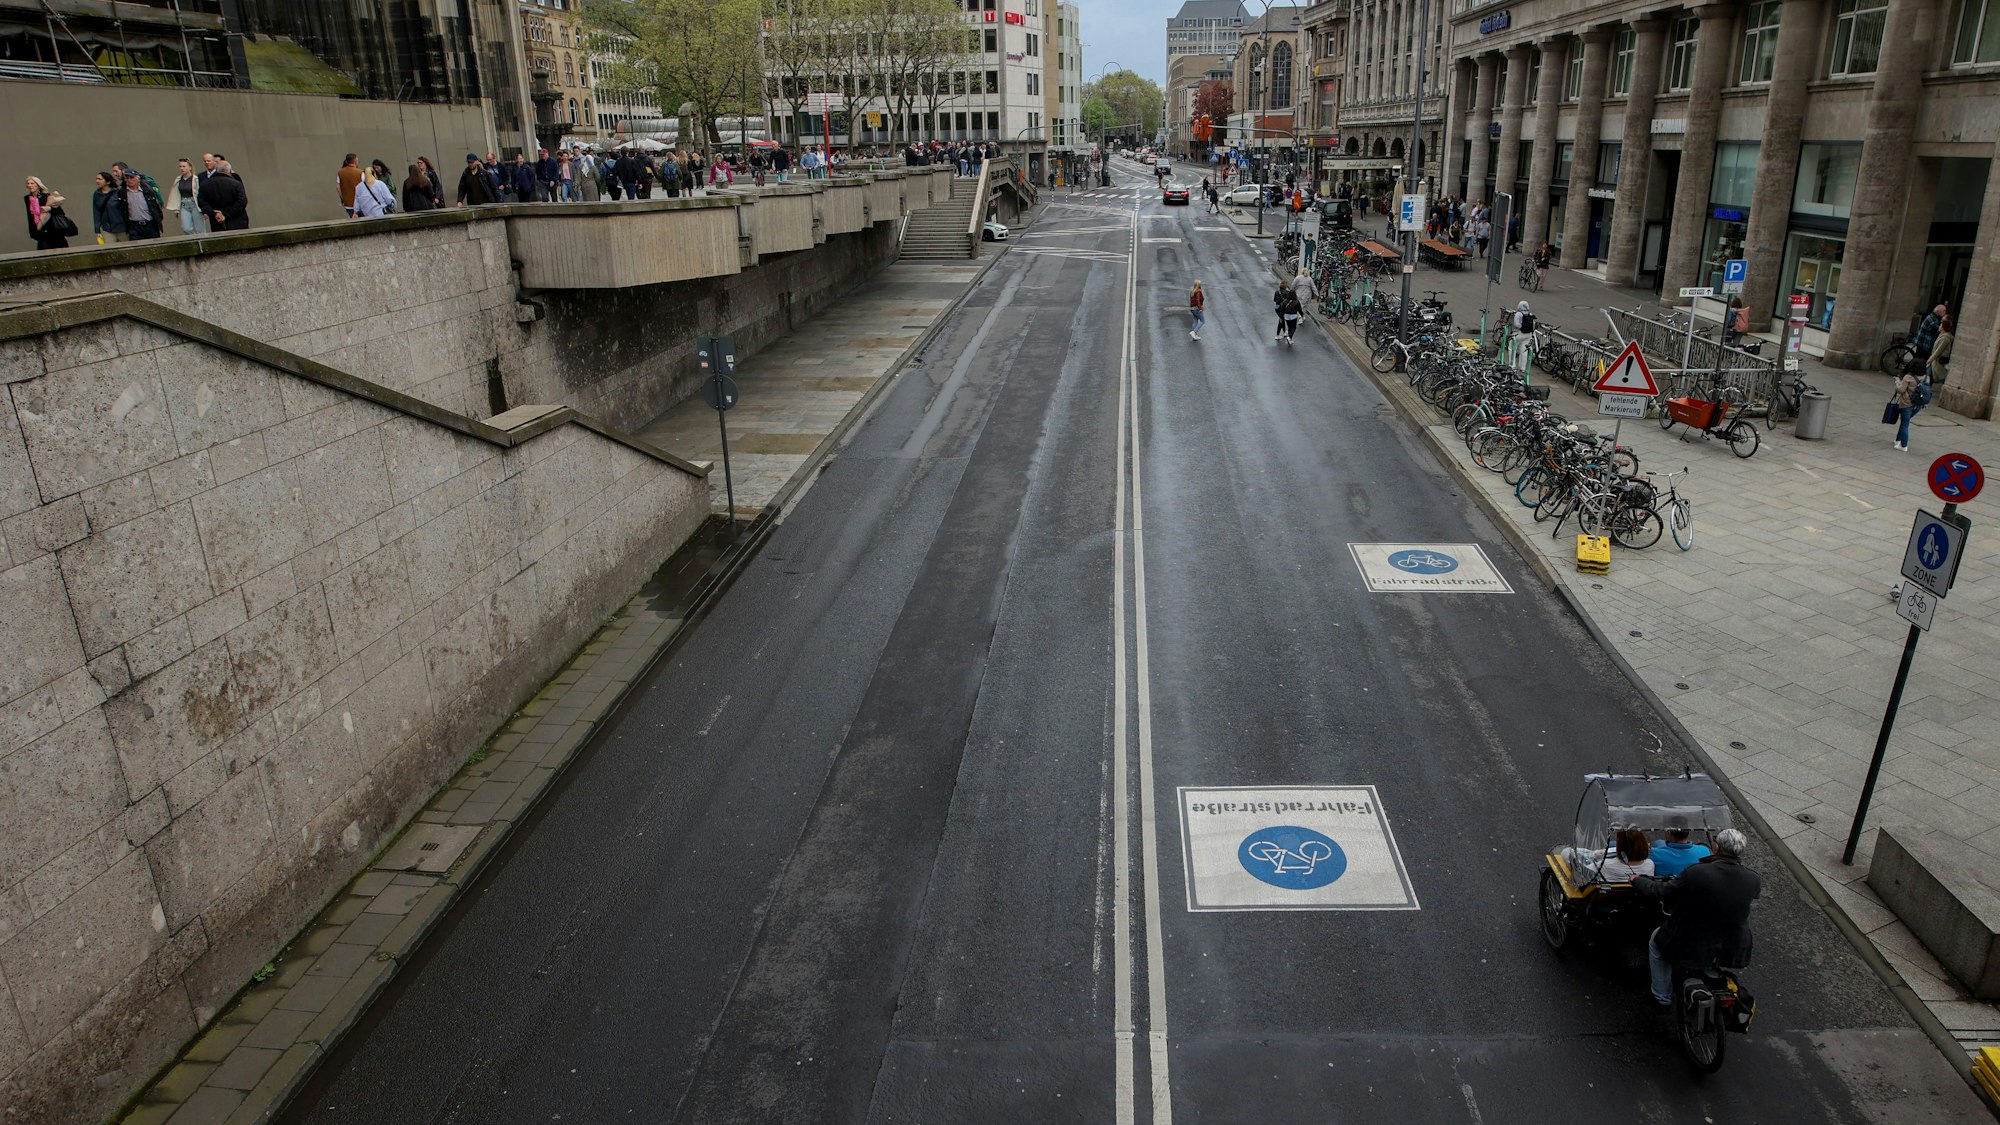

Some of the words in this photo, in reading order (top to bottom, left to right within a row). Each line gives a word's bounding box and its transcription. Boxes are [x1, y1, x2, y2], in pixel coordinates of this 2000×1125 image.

[1729, 262, 1742, 280] P
[1610, 395, 1638, 405] fehlende
[1604, 404, 1641, 415] Markierung
[1371, 576, 1498, 586] Fahrradstraße
[1912, 565, 1937, 588] ZONE
[1907, 609, 1920, 621] frei
[1192, 801, 1373, 815] Fahrradstraße
